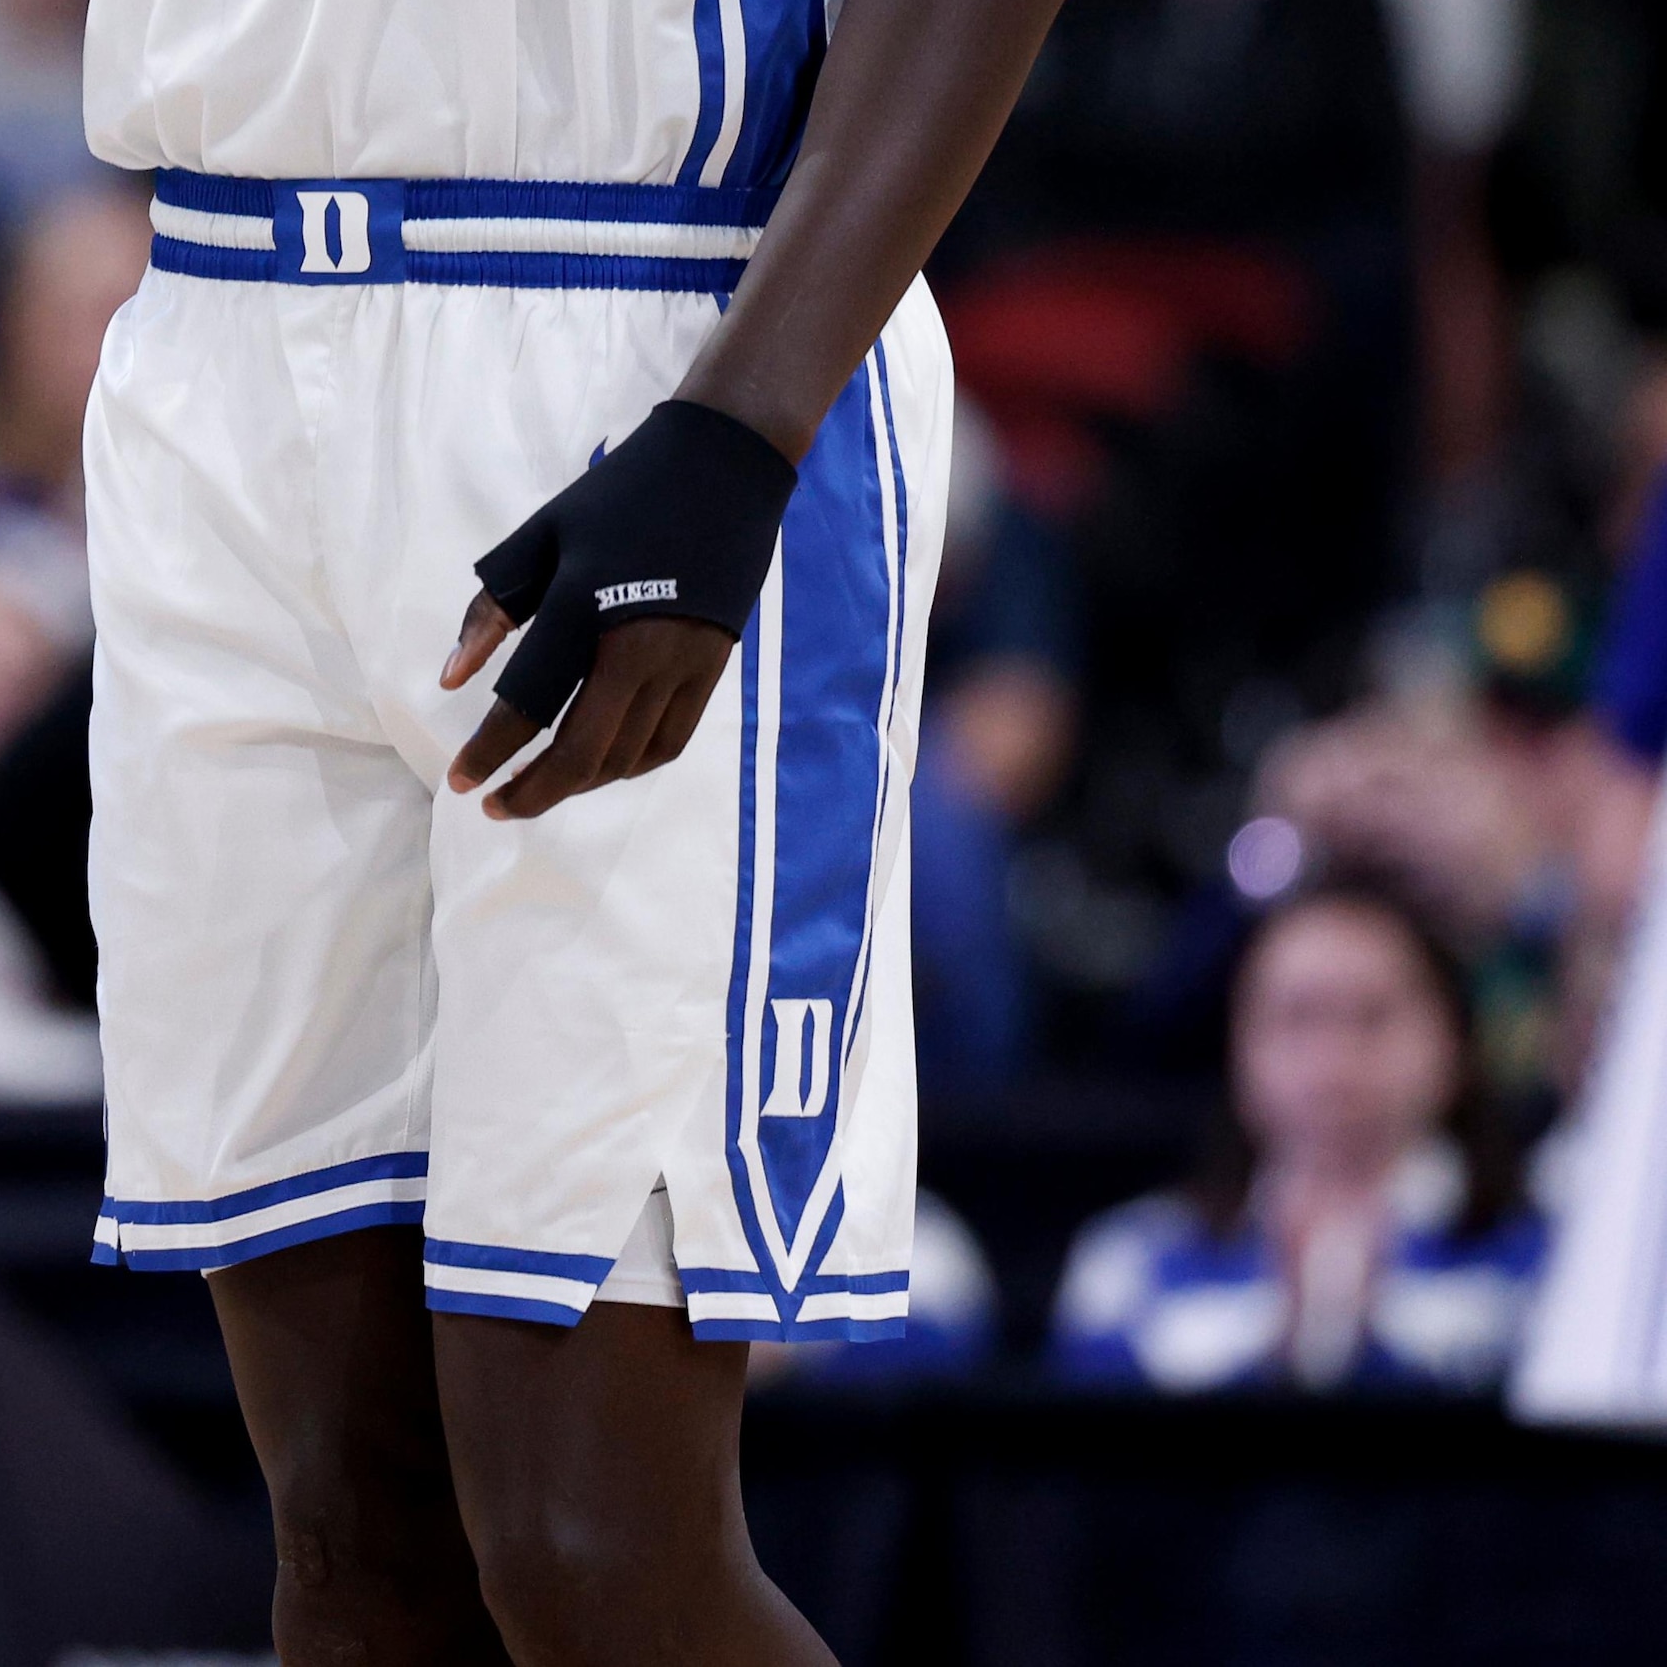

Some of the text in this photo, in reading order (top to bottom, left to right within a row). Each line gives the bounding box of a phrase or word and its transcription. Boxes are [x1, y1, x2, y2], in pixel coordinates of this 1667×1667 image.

[297, 191, 371, 273] D
[594, 579, 677, 612] BENIK
[760, 998, 832, 1118] D
